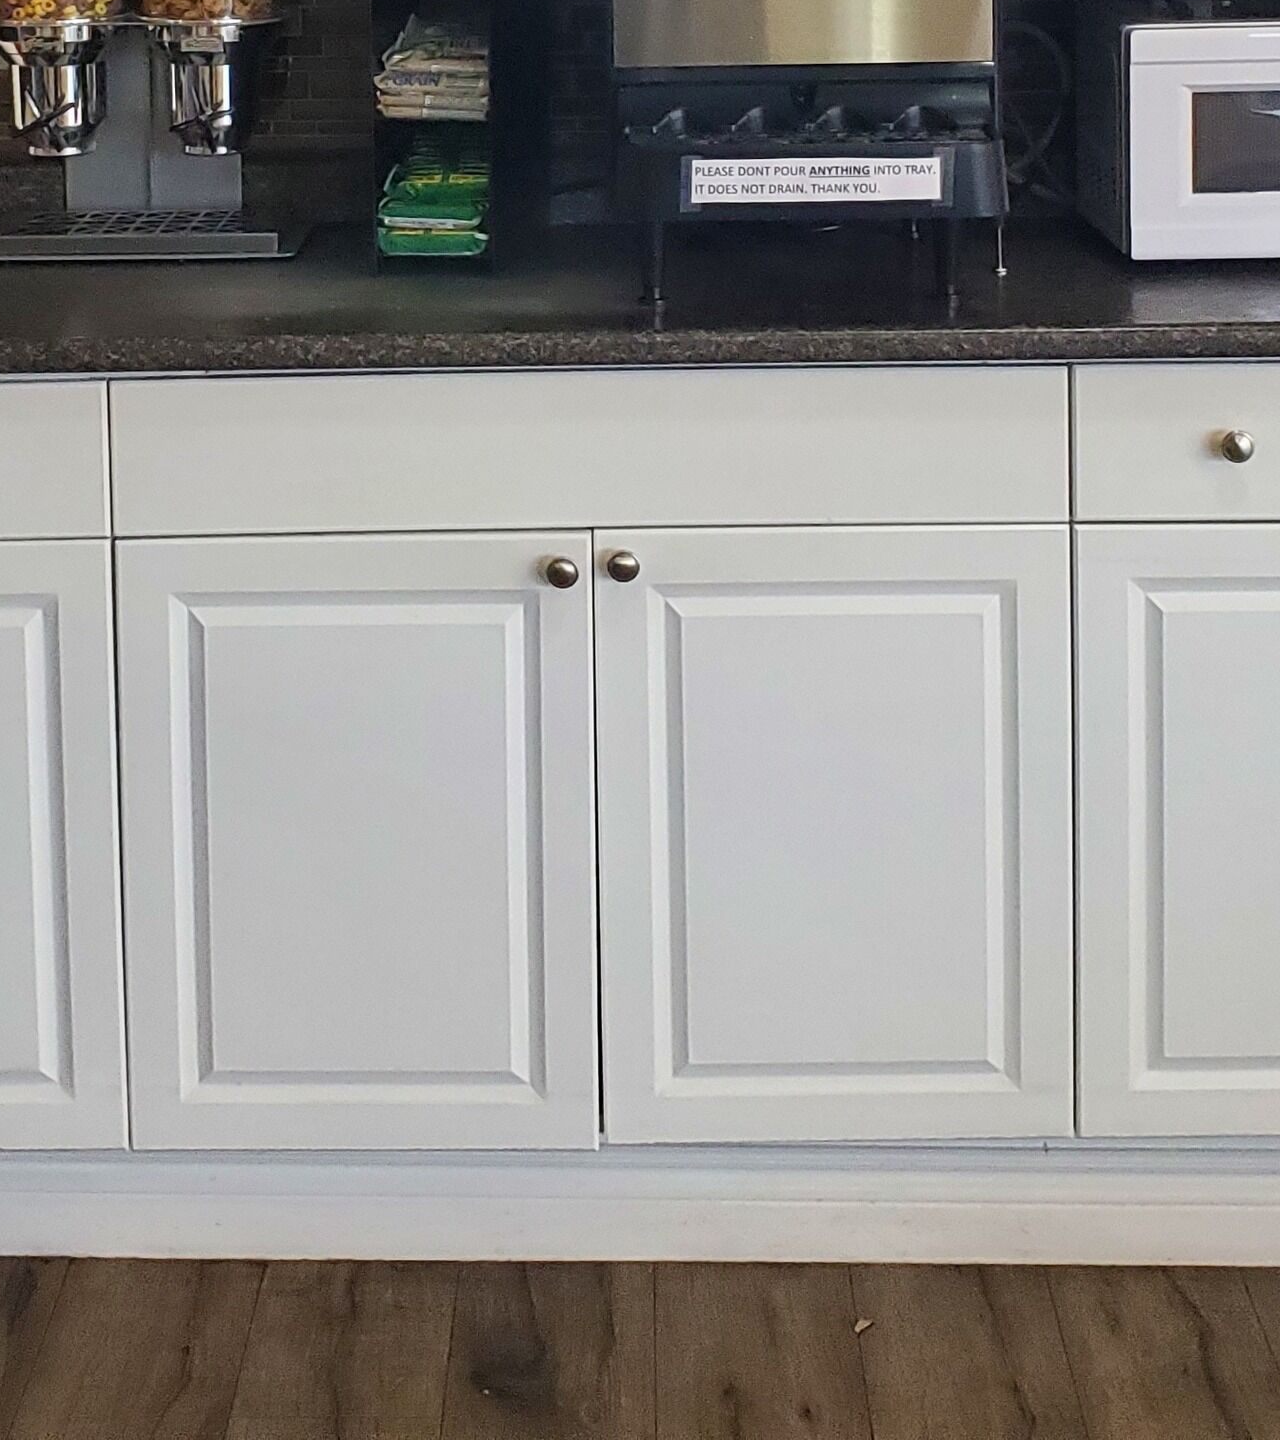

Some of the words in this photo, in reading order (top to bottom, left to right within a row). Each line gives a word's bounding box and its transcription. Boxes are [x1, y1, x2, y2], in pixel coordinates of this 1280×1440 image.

[694, 166, 734, 177] PLEASE
[738, 166, 770, 176] DONT
[774, 166, 806, 176] POUR
[809, 165, 871, 177] ANYTHING
[874, 165, 901, 175] INTO
[905, 164, 937, 175] TRAY.
[694, 184, 705, 195] IT
[708, 184, 738, 194] DOES
[741, 184, 766, 194] NOT
[769, 184, 808, 194] DRAIN.
[811, 183, 850, 194] THANK
[853, 183, 881, 194] YOU.
